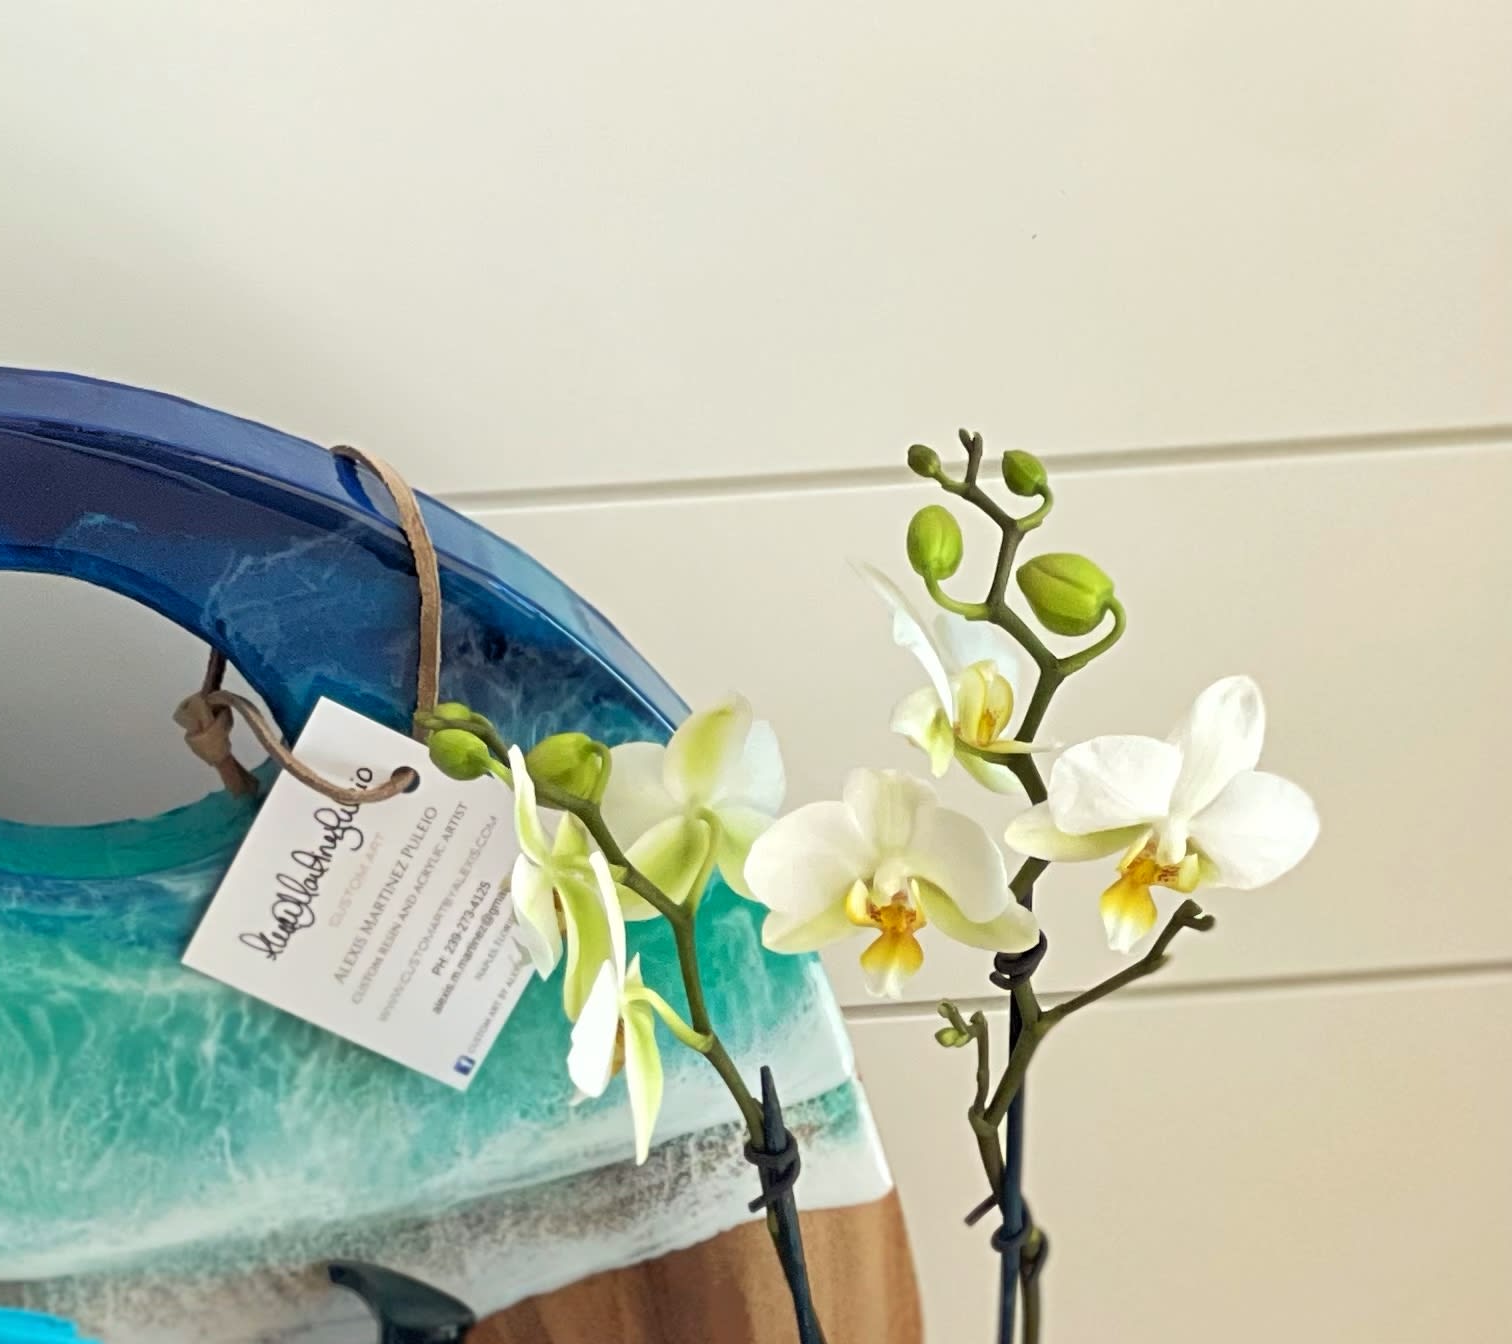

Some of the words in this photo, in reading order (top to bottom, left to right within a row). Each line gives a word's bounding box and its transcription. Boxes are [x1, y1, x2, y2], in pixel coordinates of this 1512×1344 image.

[349, 954, 384, 1006] CUSTOM
[395, 892, 418, 922] AND
[438, 800, 469, 842] ARTIST
[357, 857, 409, 936] MARTINEZ
[399, 803, 439, 859] PULEIO
[361, 830, 387, 864] ART
